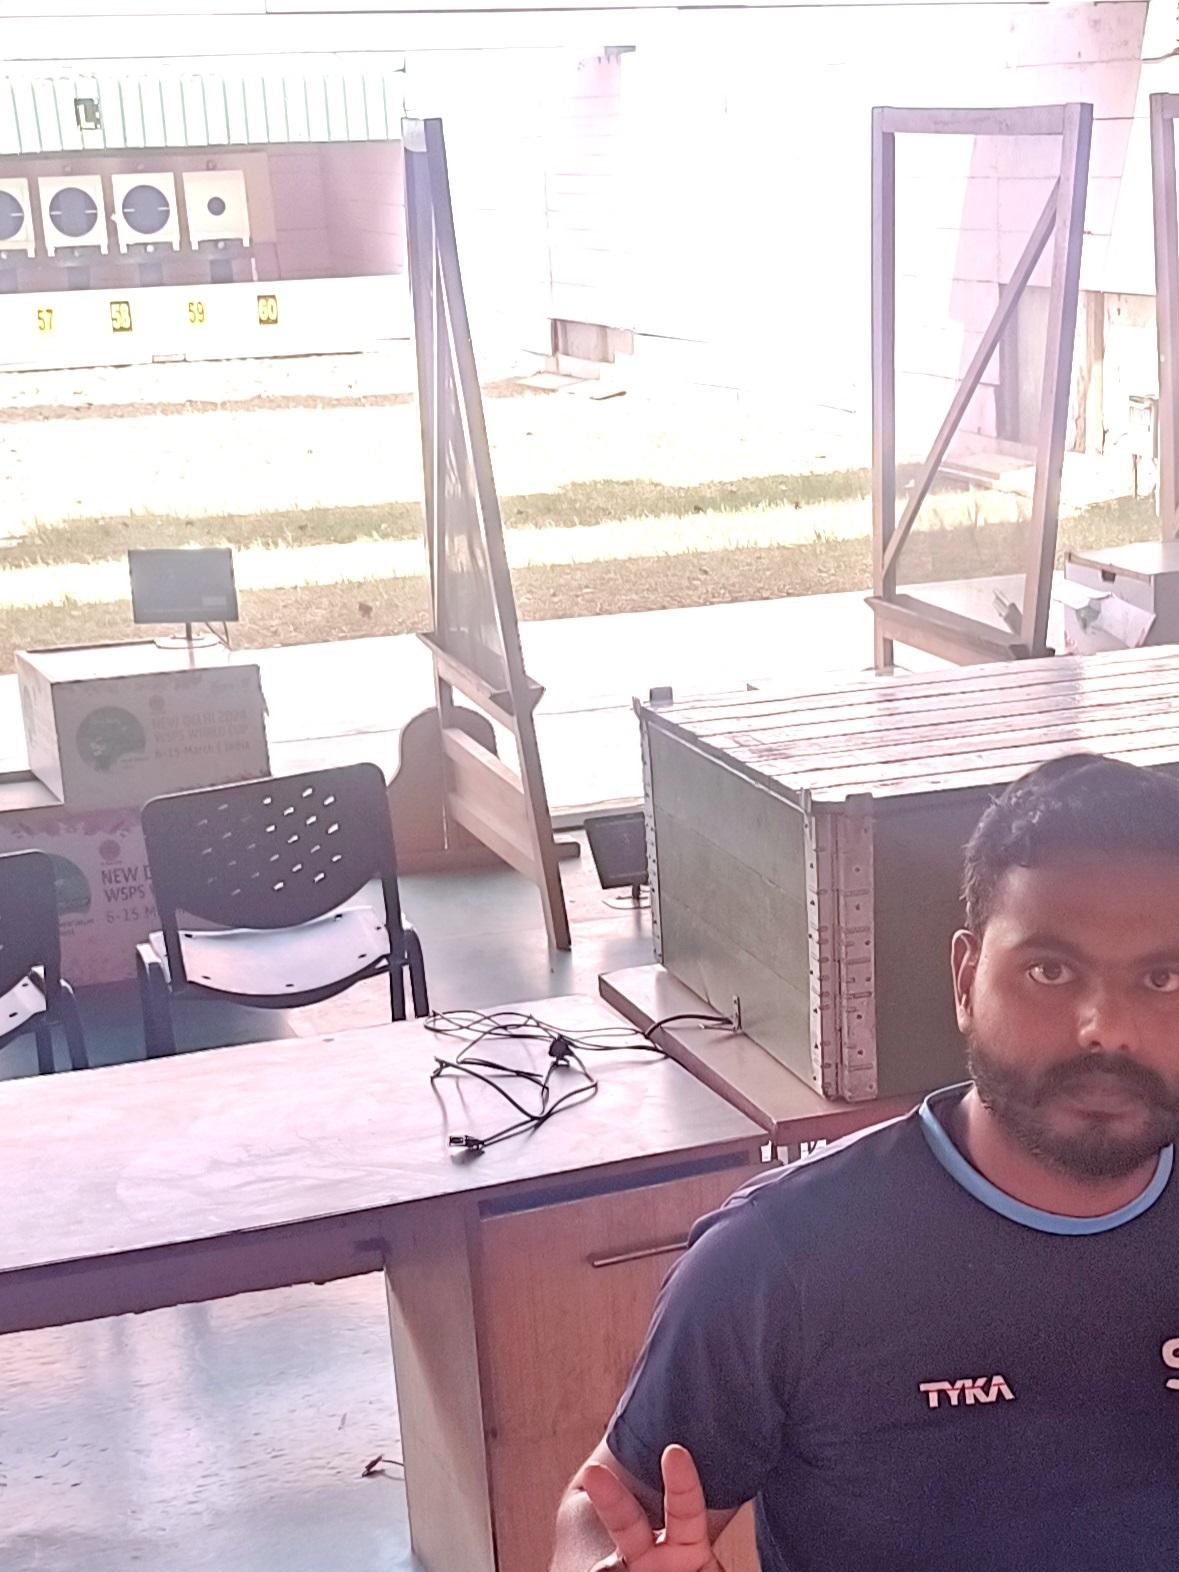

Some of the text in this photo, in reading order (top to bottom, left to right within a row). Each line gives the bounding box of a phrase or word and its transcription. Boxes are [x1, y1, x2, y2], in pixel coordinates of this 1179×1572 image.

[37, 308, 54, 331] 57
[187, 301, 205, 323] 59
[101, 866, 139, 886] NEW
[104, 885, 145, 903] WSPS
[919, 1374, 1015, 1409] TYKA
